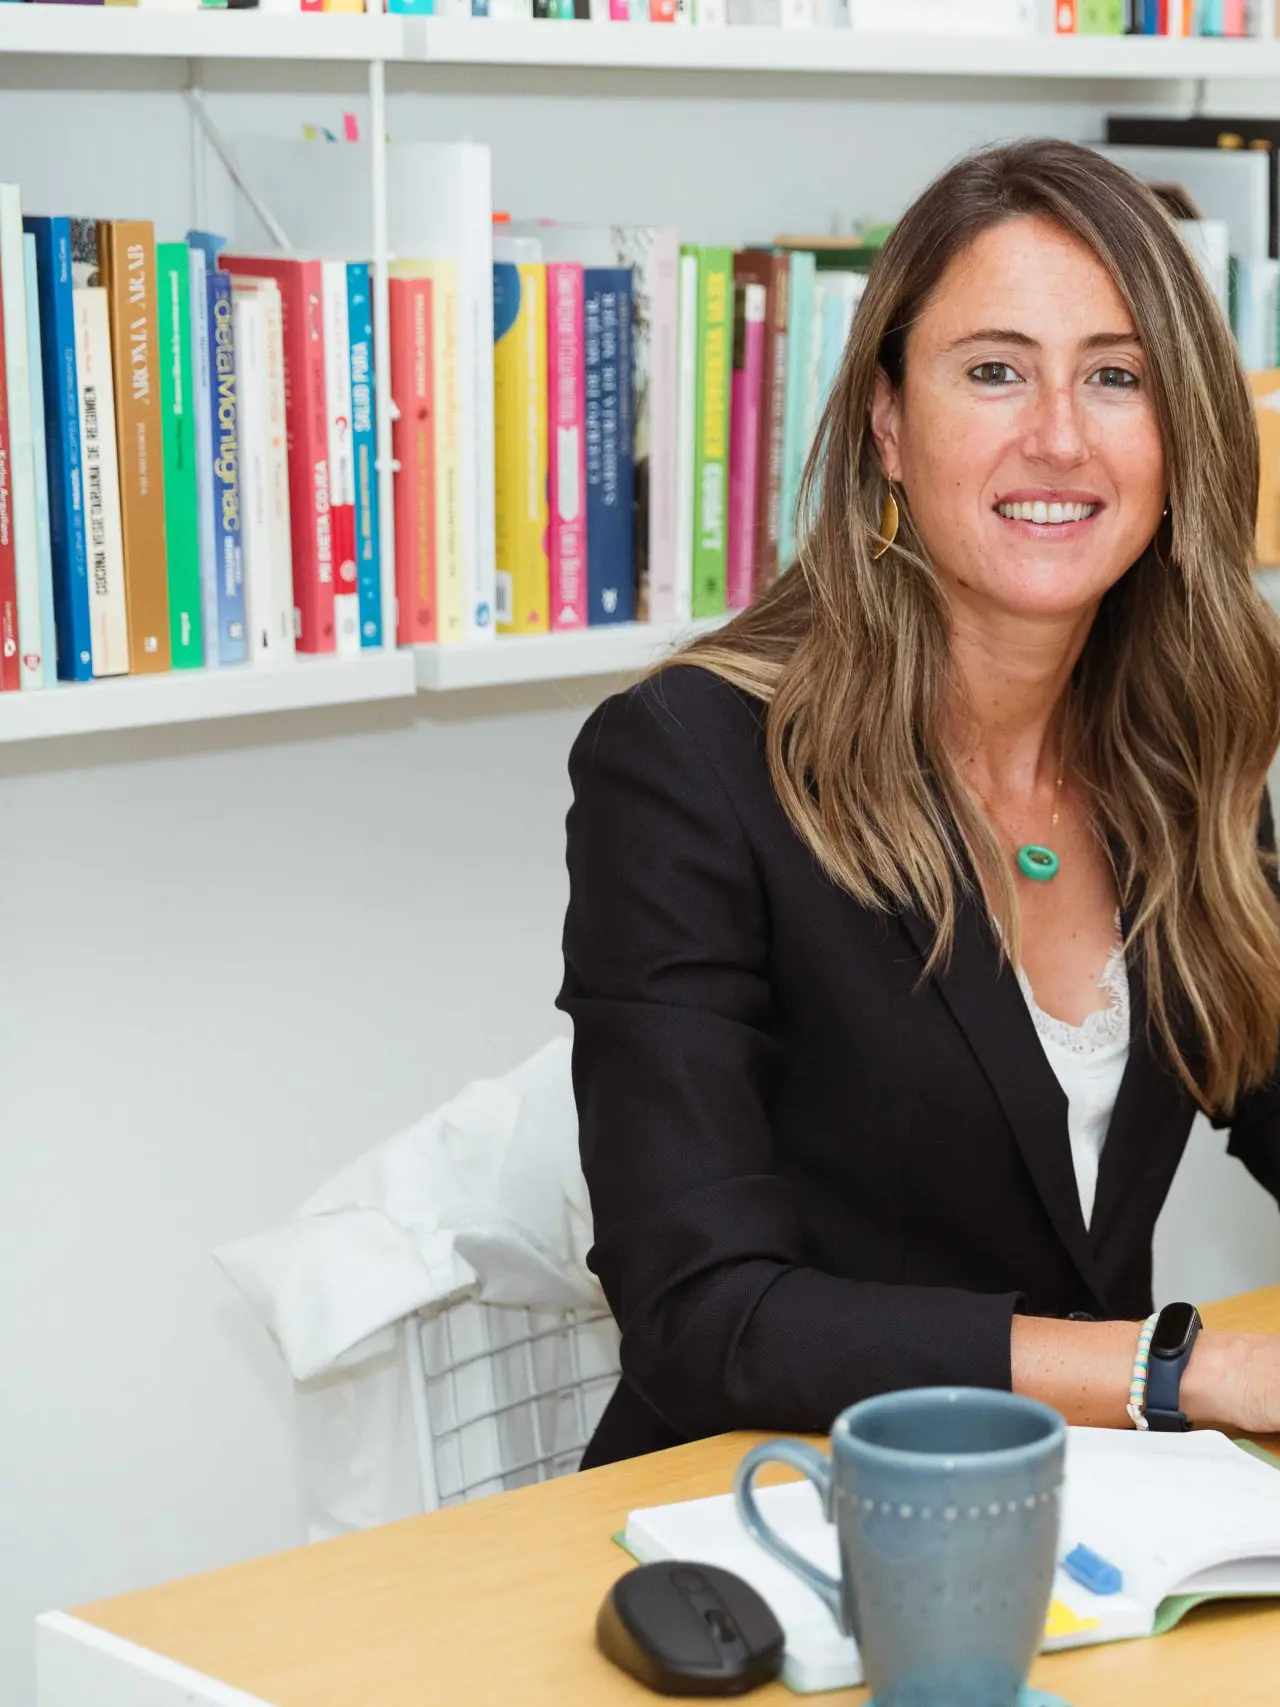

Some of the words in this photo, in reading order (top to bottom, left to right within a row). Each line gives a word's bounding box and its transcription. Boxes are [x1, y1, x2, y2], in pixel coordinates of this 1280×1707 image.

[601, 292, 618, 358] MUJER
[130, 317, 150, 406] AROMA
[351, 341, 369, 383] PURA
[602, 366, 617, 391] DE
[352, 384, 371, 432] SALUD
[586, 374, 600, 398] DE
[86, 446, 99, 460] DE
[586, 400, 600, 485] CUERPO
[89, 466, 104, 545] VEGETARIANA
[313, 459, 330, 514] COJEA
[316, 514, 331, 562] DIETA
[94, 552, 108, 596] COCINA
[318, 562, 332, 583] MI
